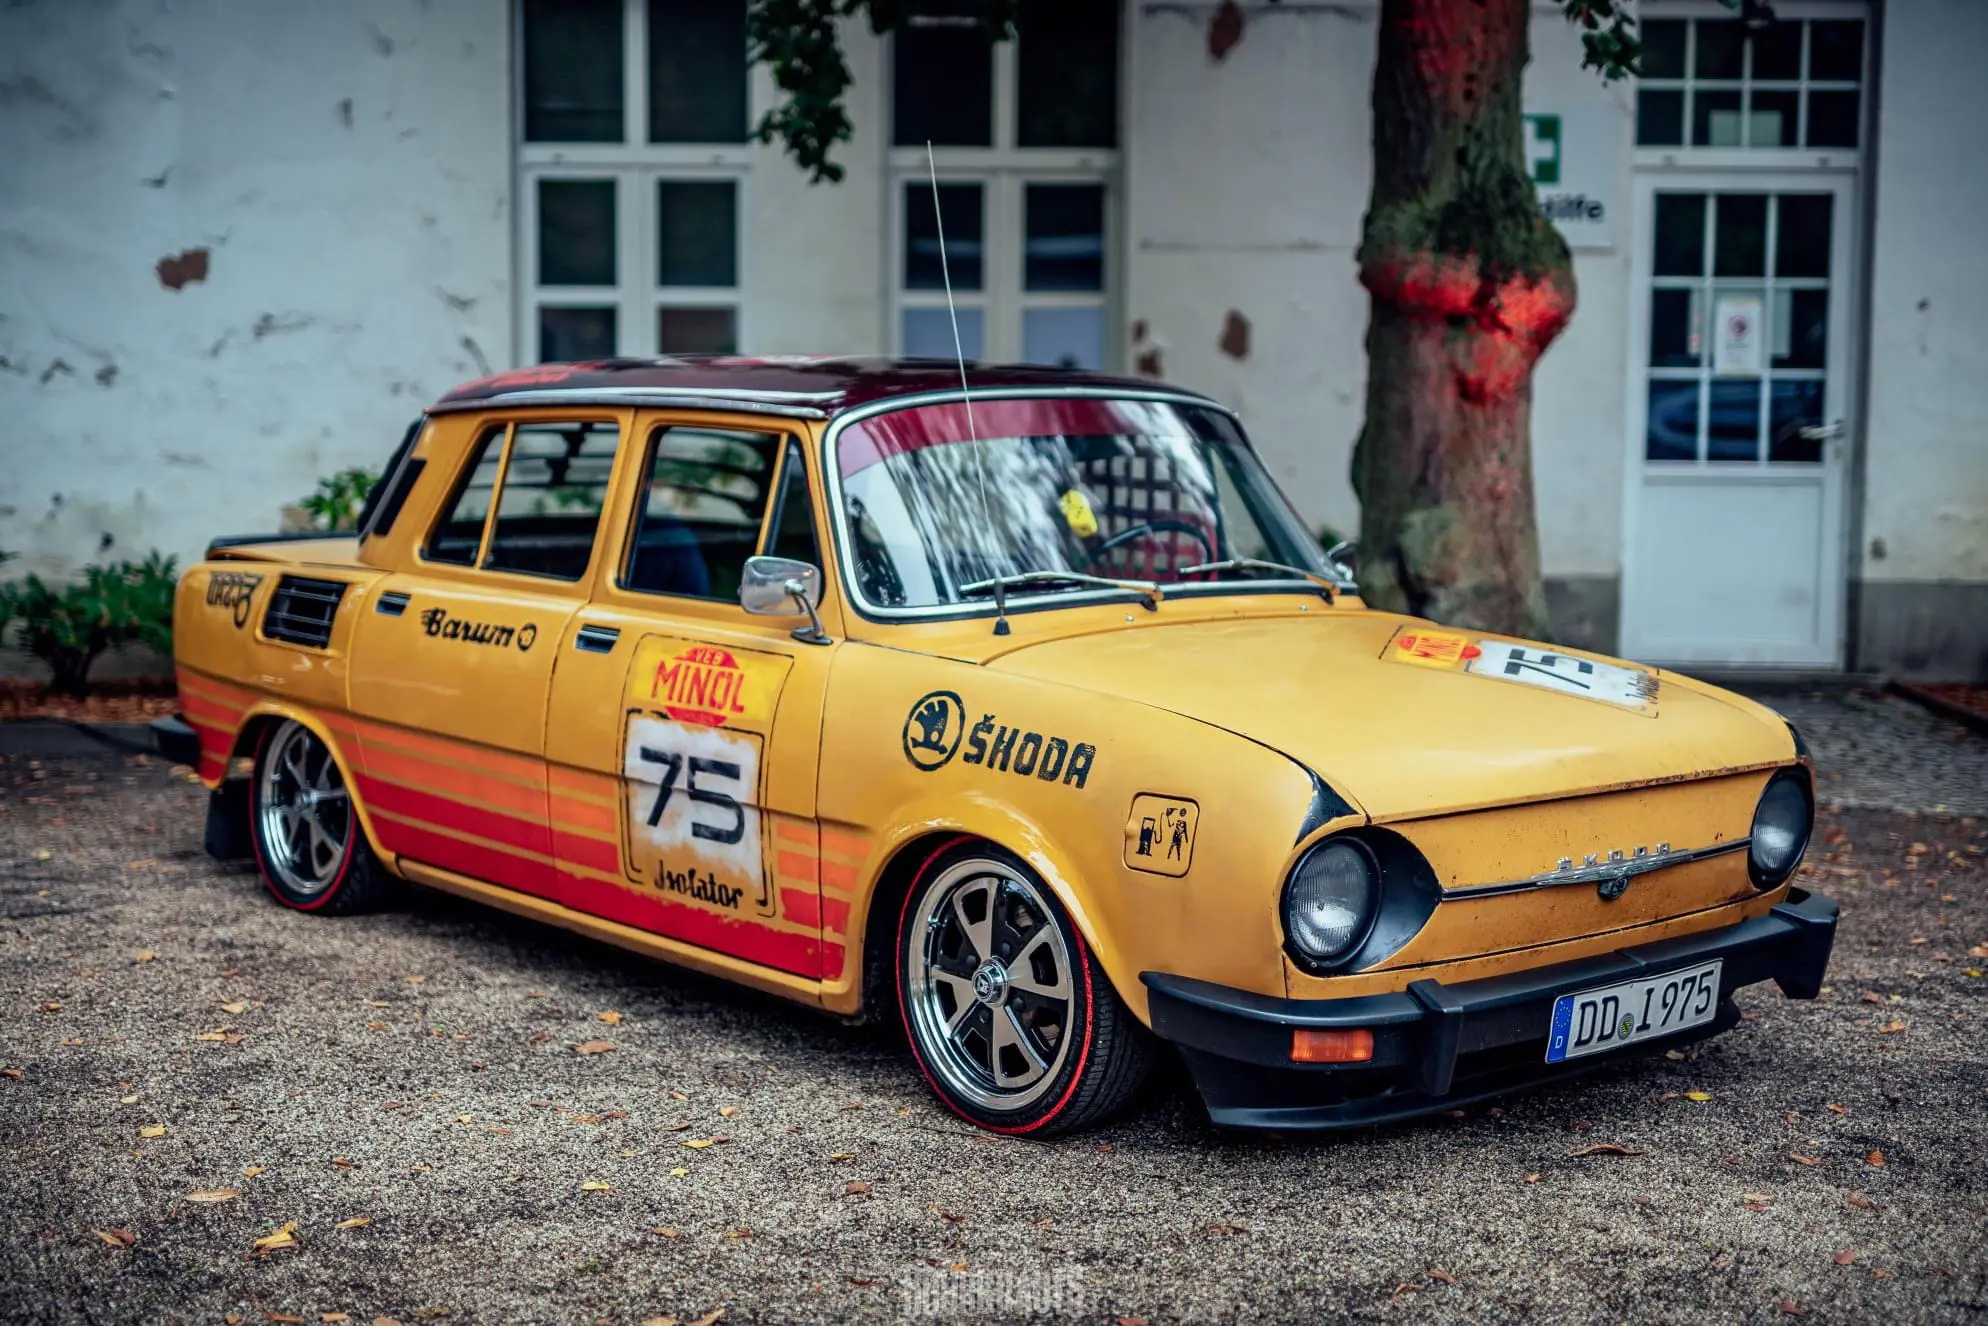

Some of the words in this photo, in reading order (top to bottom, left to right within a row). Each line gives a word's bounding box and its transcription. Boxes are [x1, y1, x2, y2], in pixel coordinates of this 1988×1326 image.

[421, 607, 514, 648] Barum
[651, 660, 745, 713] MINOL
[639, 745, 745, 845] 75
[1574, 996, 1620, 1048] DD
